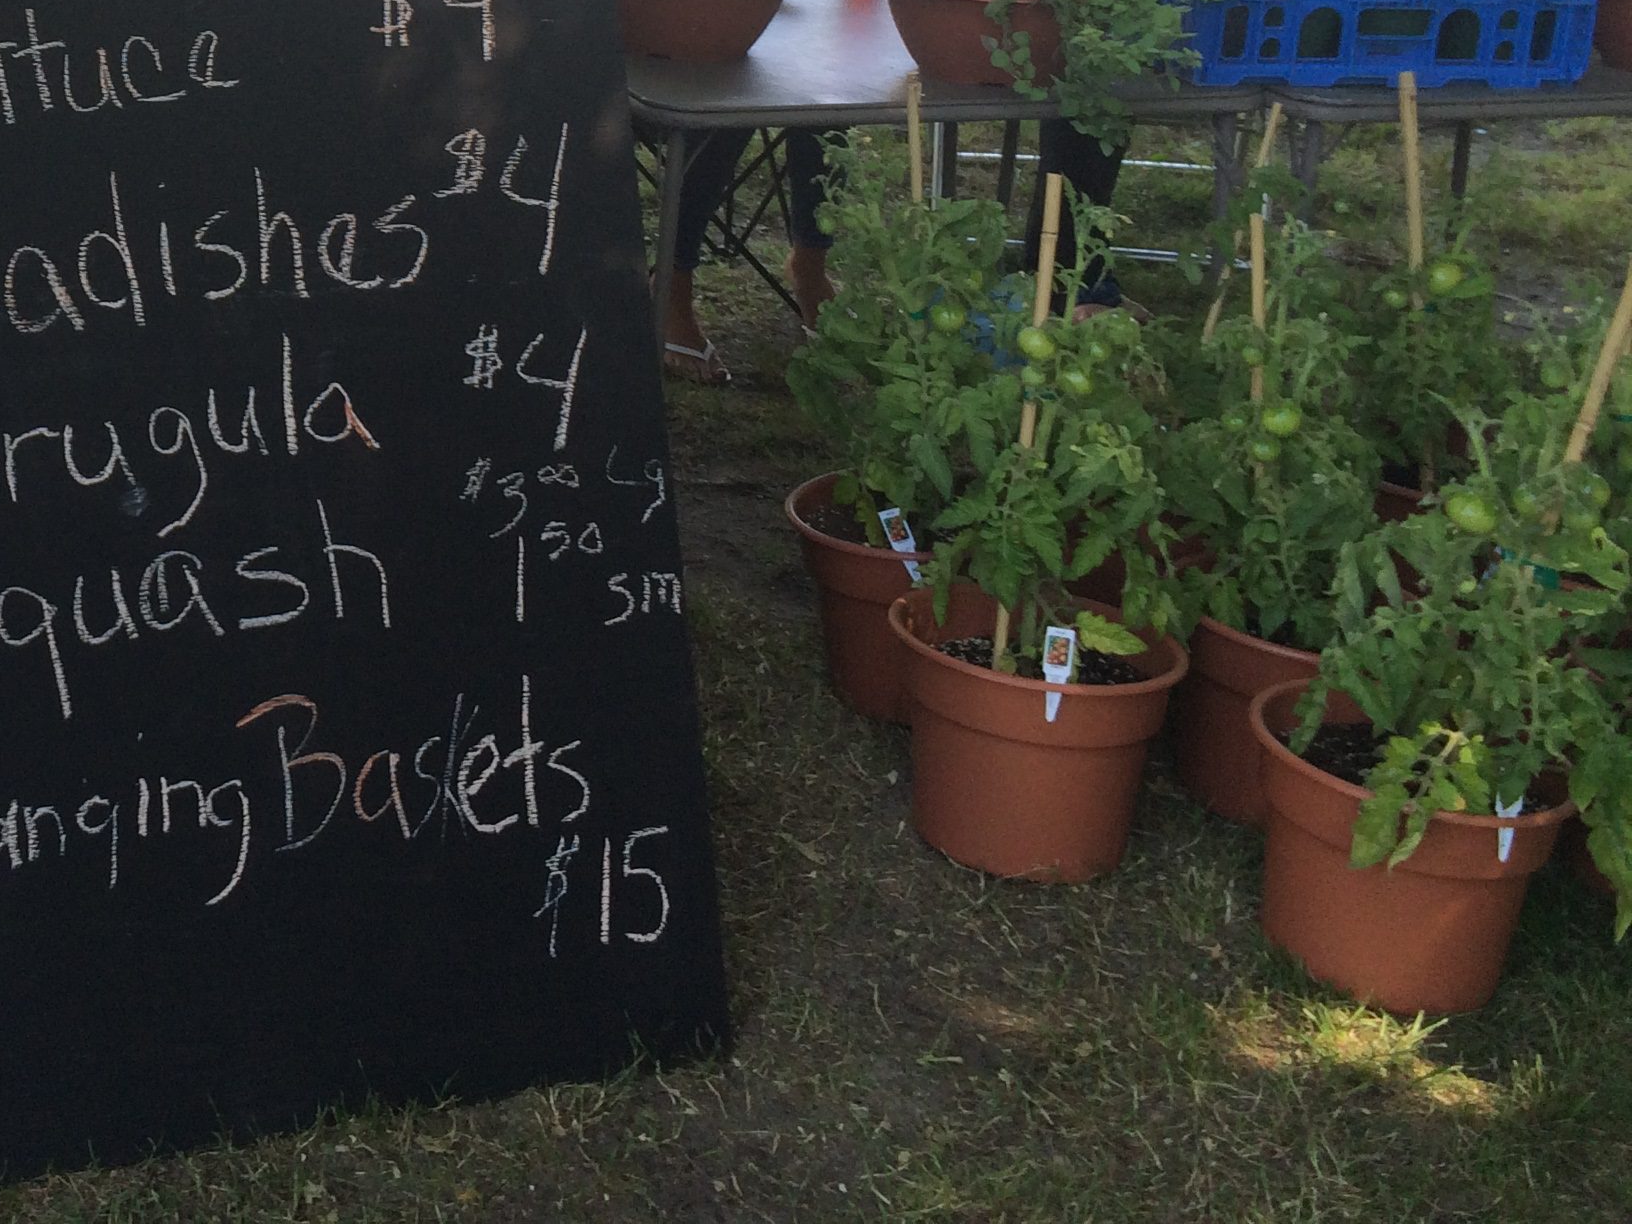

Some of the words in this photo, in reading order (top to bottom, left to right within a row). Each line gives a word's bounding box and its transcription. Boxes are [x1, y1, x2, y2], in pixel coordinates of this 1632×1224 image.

[434, 123, 568, 274] $4
[464, 324, 586, 449] $4
[236, 675, 590, 852] Baskets
[533, 826, 670, 958] $15
